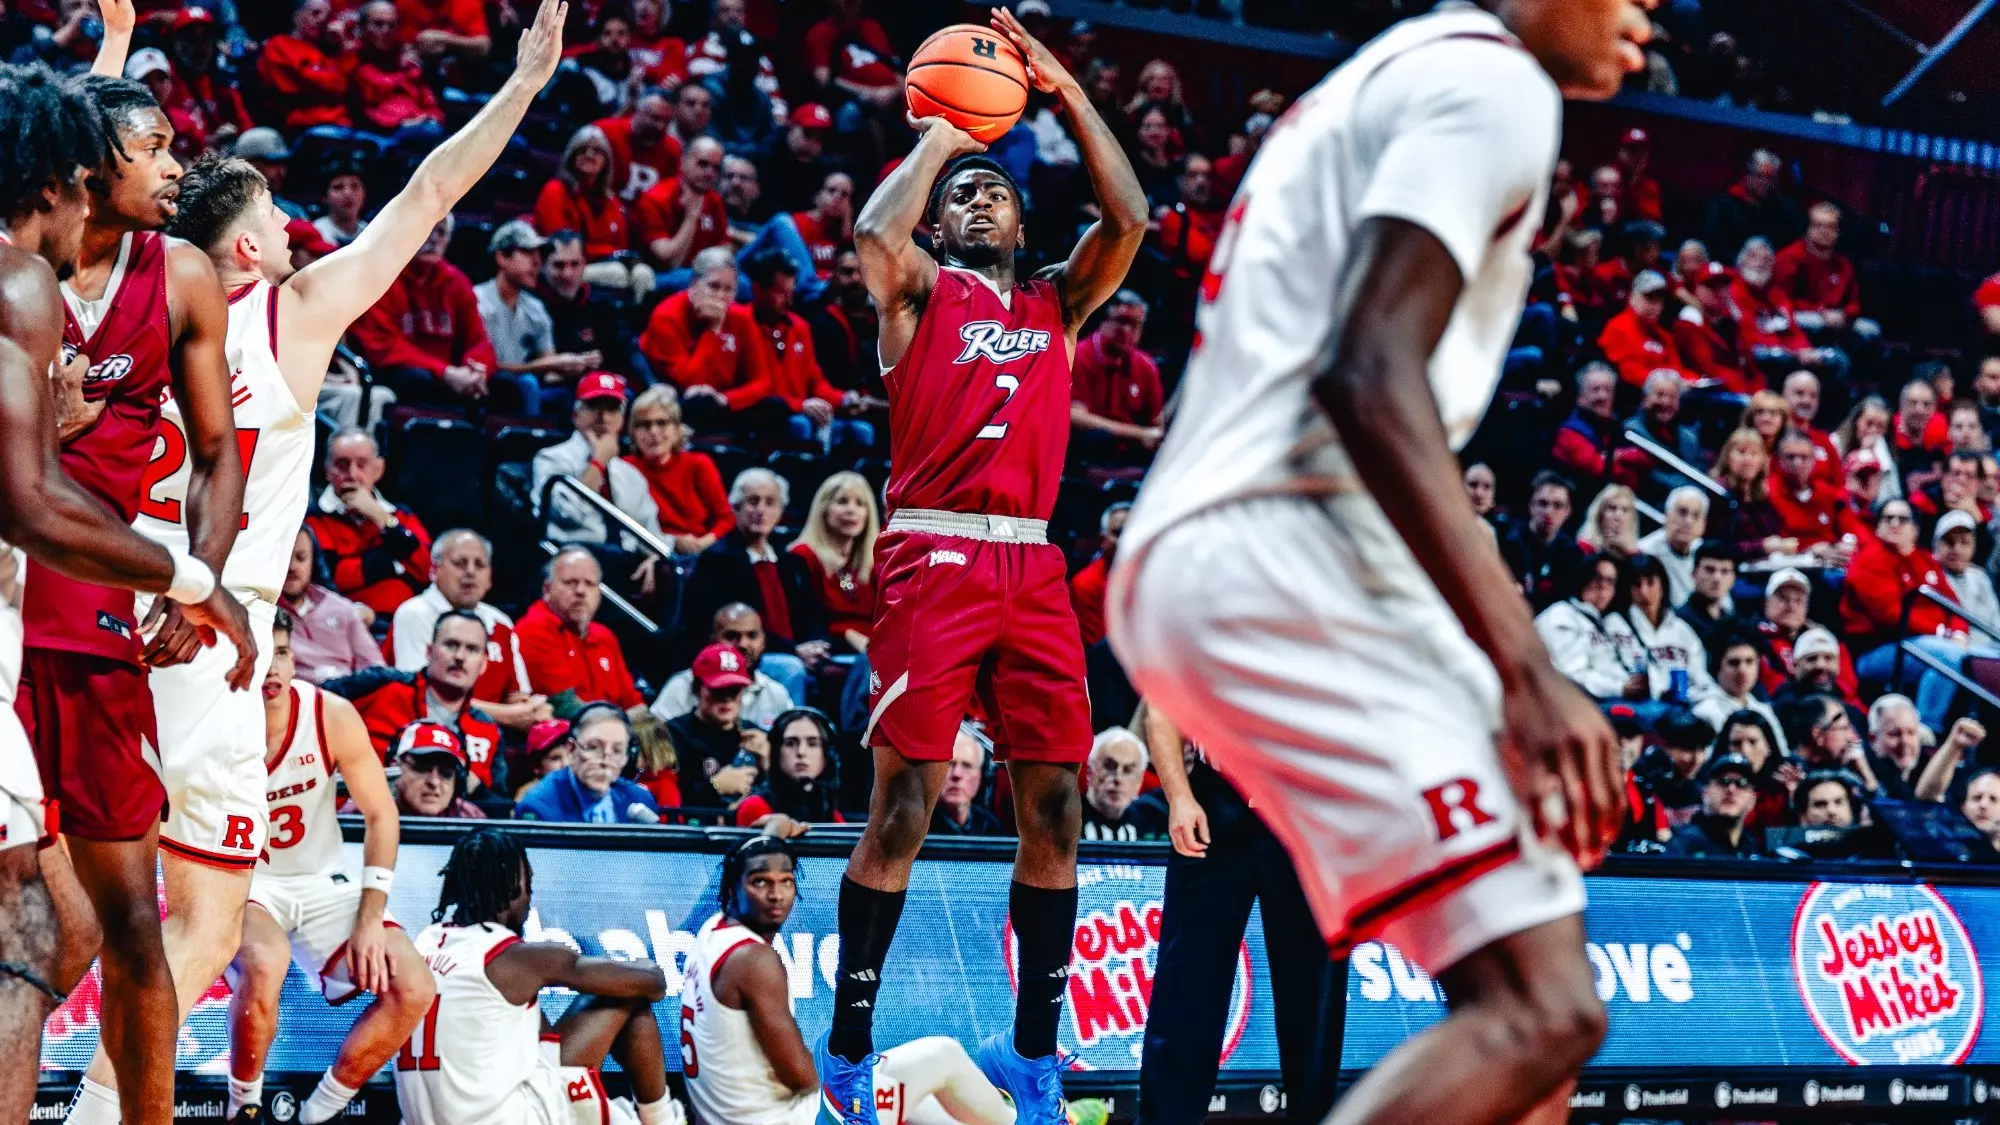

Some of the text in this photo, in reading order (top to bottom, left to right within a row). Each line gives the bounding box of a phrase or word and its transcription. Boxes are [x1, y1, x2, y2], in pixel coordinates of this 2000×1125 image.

[971, 36, 997, 60] R
[975, 373, 1020, 440] 2
[138, 416, 261, 531] 2
[431, 729, 453, 748] R
[1421, 776, 1497, 842] R
[221, 814, 255, 850] R
[1820, 915, 1944, 977] Jersey
[1351, 941, 1449, 1003] su
[566, 1074, 593, 1104] R
[876, 1087, 895, 1111] R
[1642, 1088, 1689, 1107] Prudential
[1732, 1087, 1778, 1105] Prudential
[1819, 1084, 1866, 1102] Prudential
[1905, 1084, 1949, 1101] Prudential
